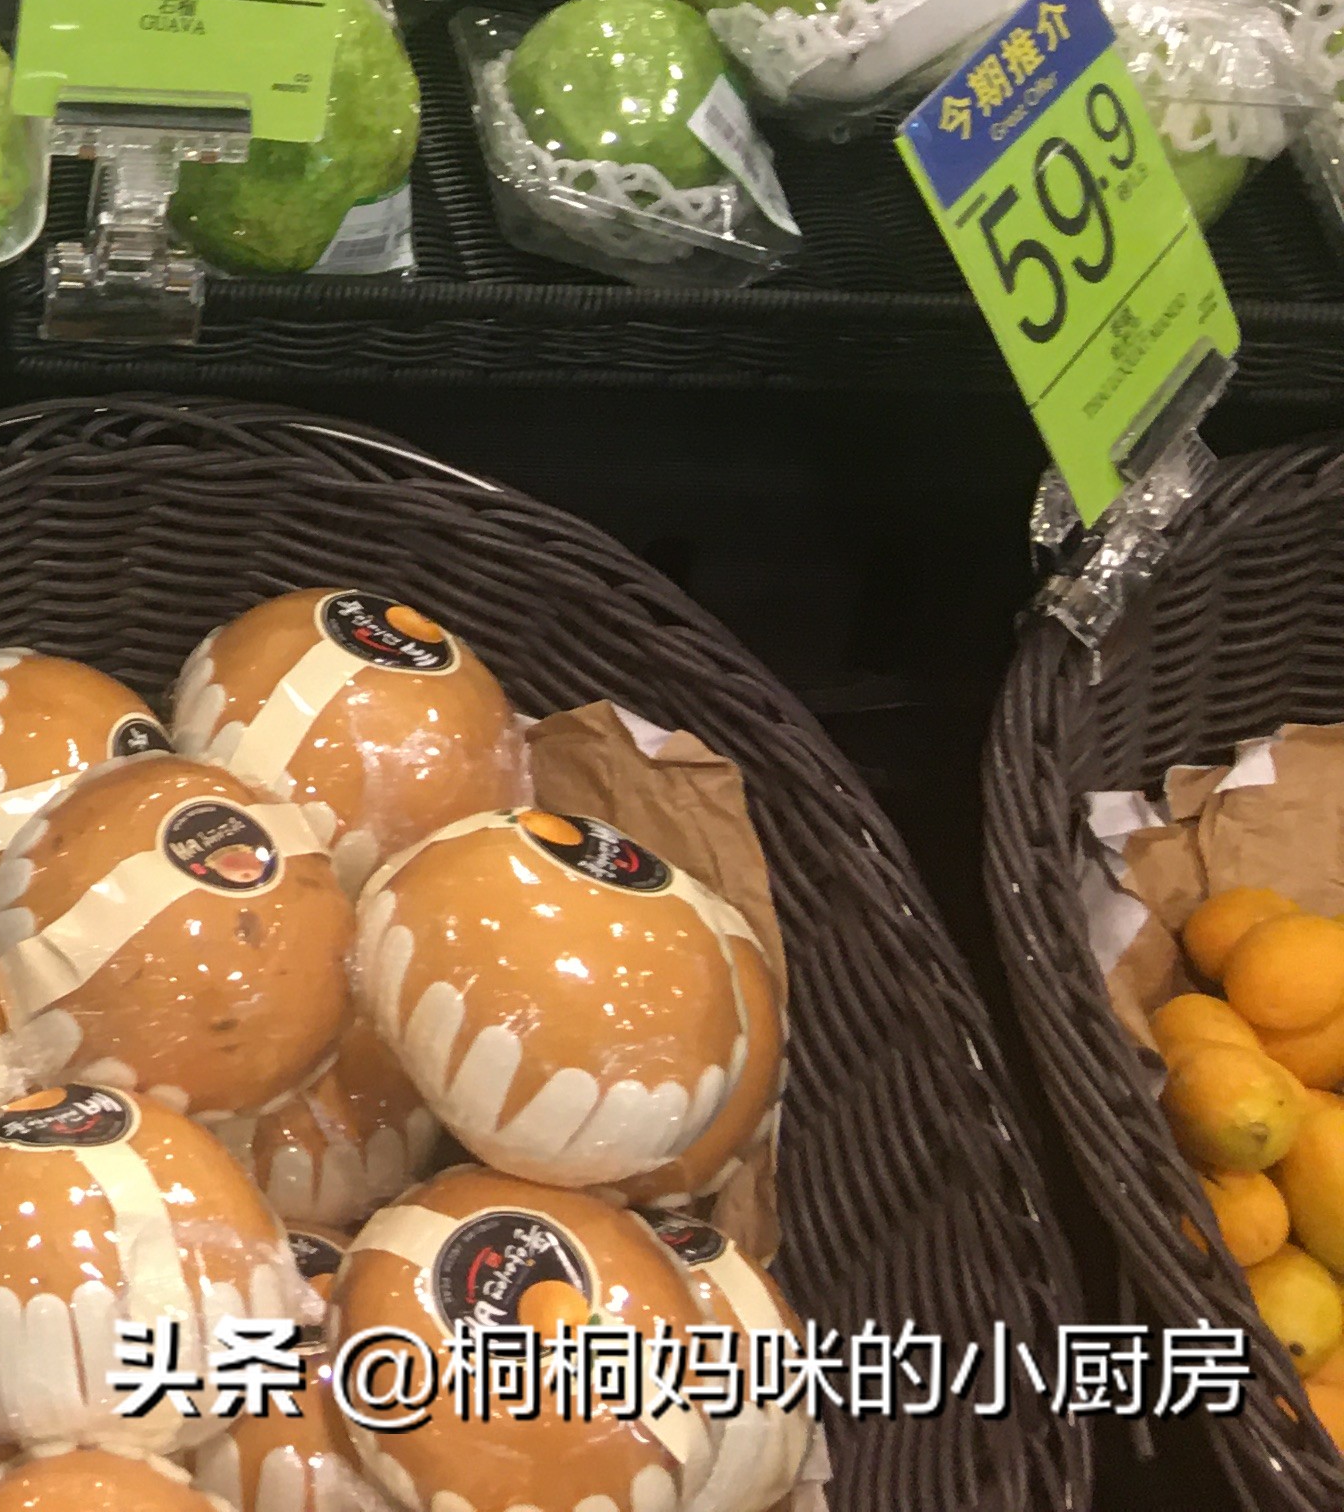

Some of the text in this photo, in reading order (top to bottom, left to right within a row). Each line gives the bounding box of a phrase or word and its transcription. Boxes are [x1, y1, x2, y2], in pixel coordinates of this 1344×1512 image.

[936, 0, 1072, 141] 今期推介
[979, 83, 1137, 344] 59.9
